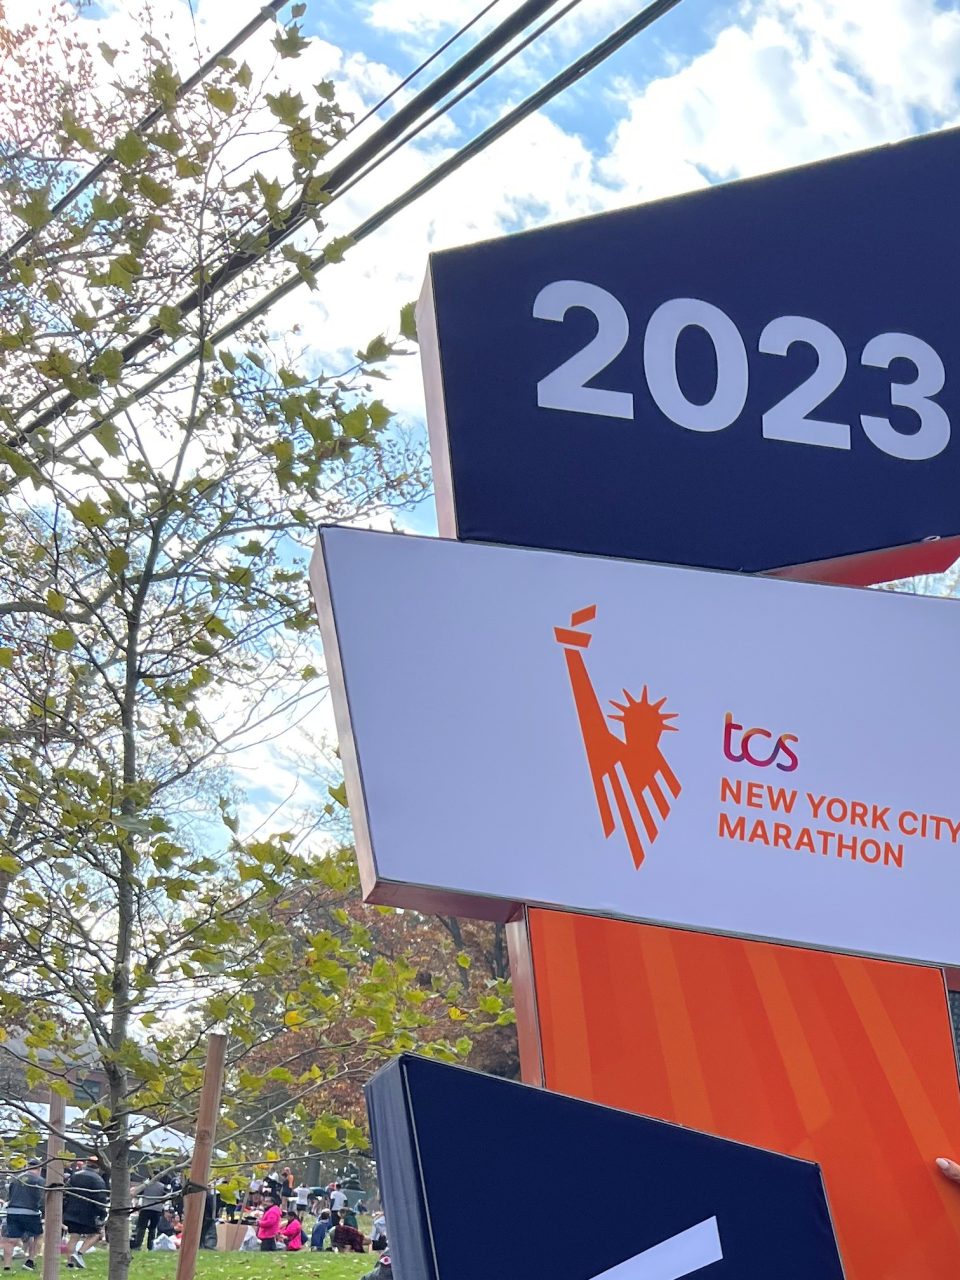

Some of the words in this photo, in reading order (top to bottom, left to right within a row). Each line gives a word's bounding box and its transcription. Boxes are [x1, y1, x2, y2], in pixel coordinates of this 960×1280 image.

[532, 280, 952, 461] 2023
[723, 711, 799, 773] tcs
[720, 777, 798, 814] NEW
[806, 792, 892, 832] YORK
[718, 813, 905, 868] MARATHON
